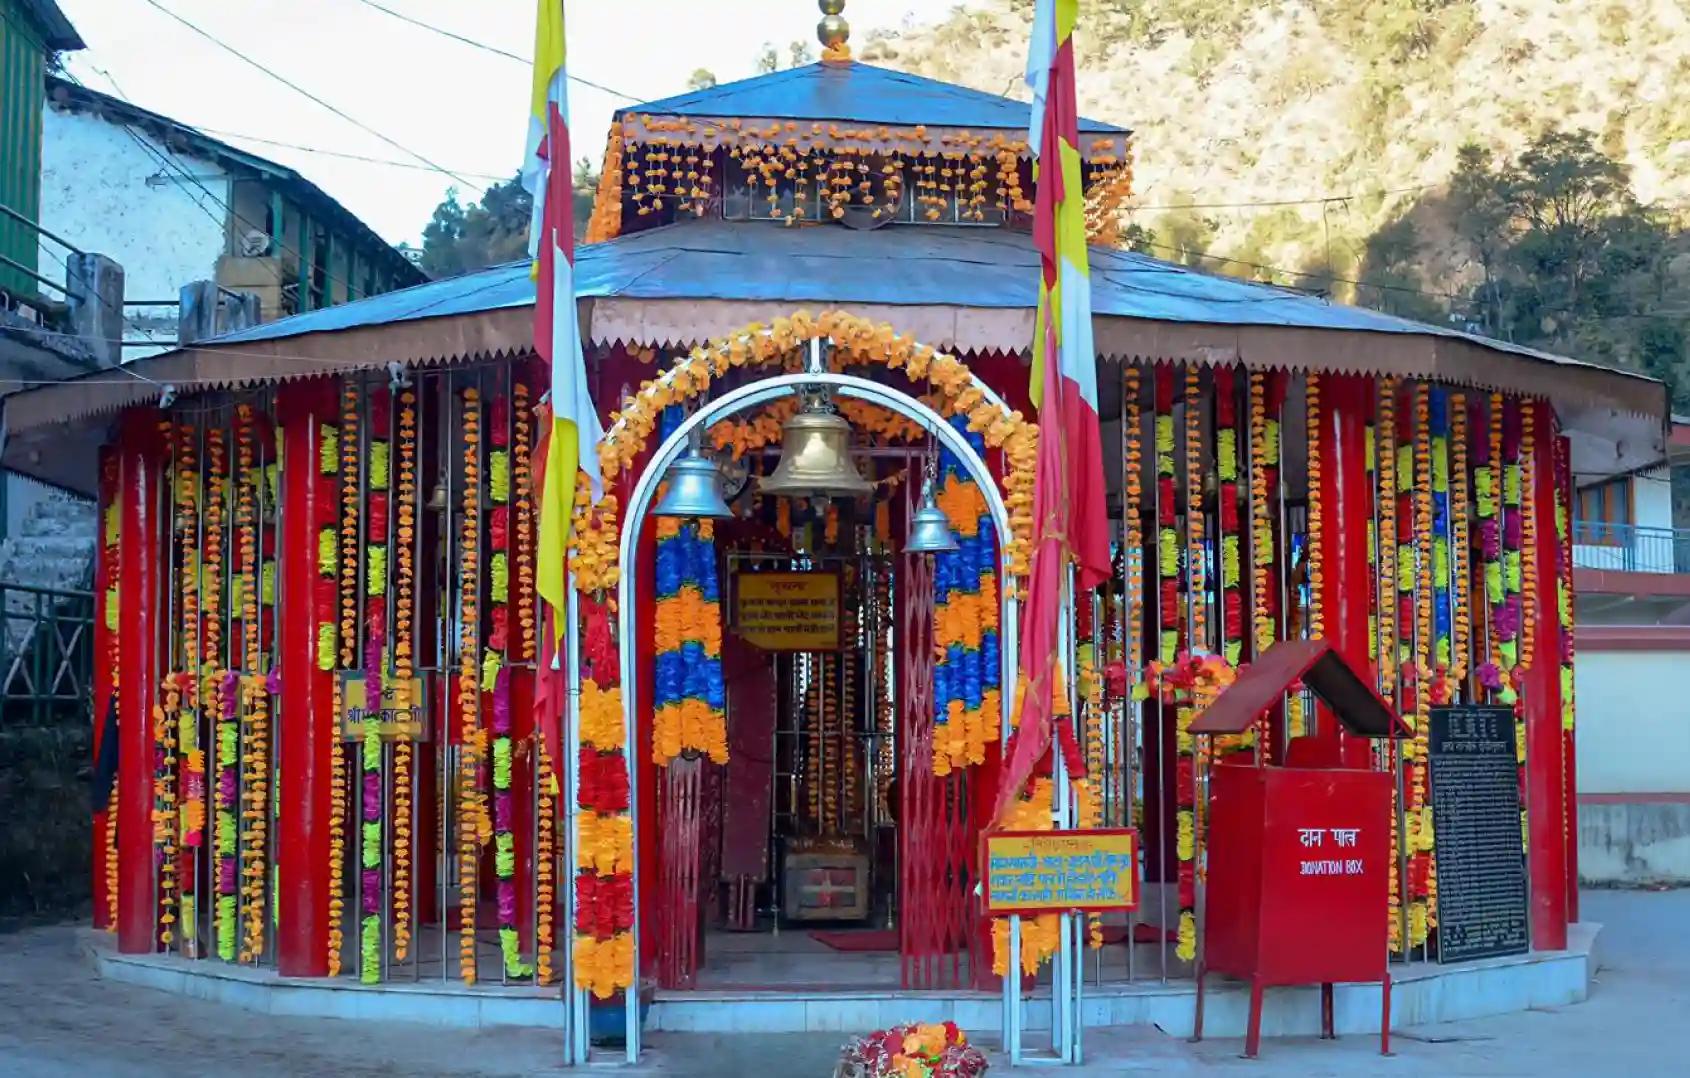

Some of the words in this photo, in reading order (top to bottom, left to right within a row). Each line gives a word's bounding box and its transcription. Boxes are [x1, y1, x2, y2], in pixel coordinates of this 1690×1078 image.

[1297, 828, 1326, 847] दान
[1300, 860, 1343, 874] DONATION
[1346, 859, 1363, 874] BOX
